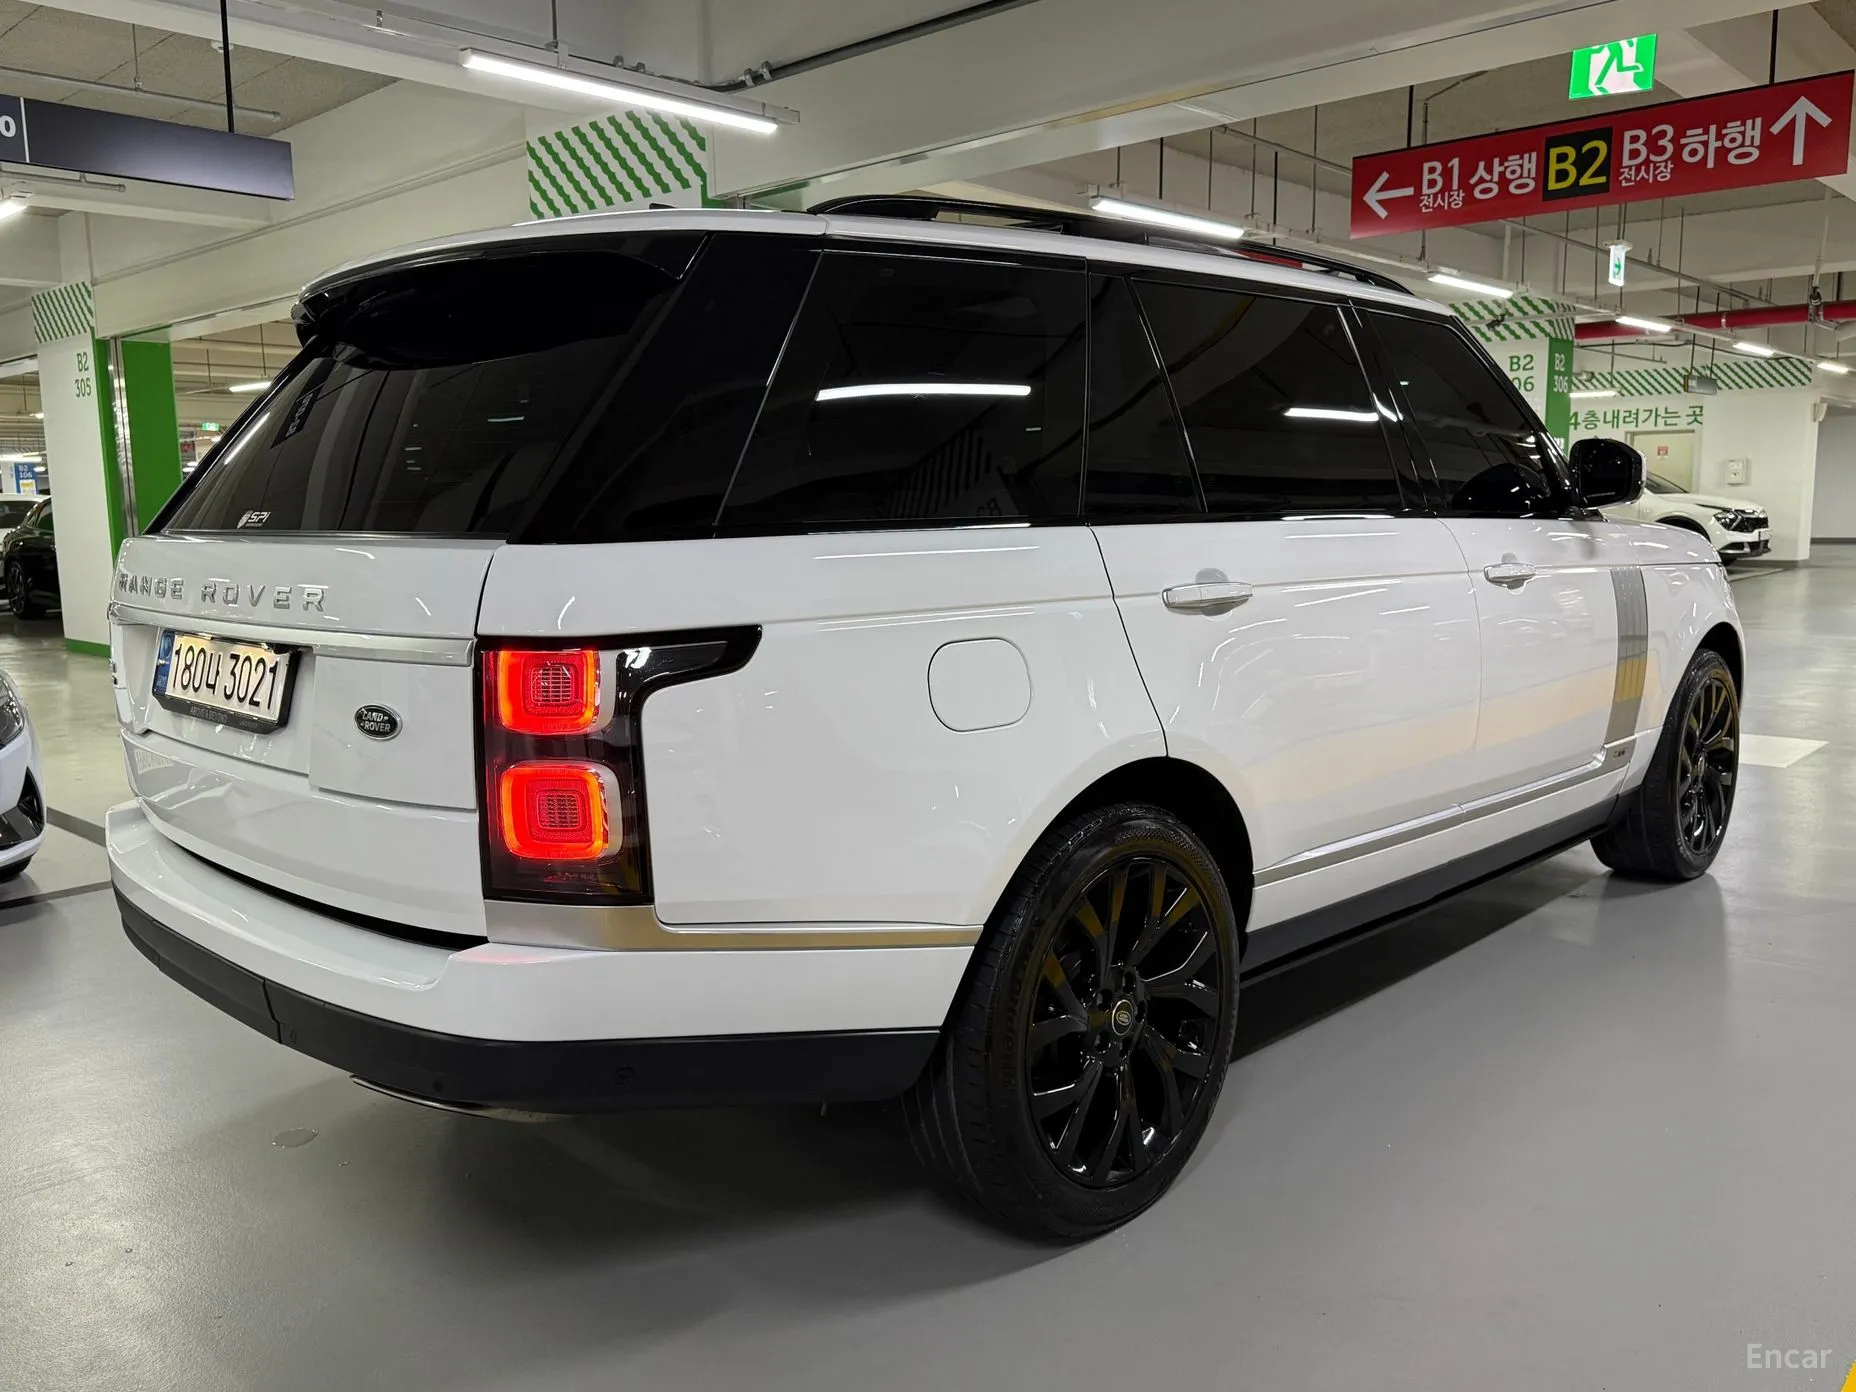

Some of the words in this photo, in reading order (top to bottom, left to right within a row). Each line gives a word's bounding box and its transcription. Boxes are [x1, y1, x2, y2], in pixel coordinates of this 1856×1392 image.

[1622, 124, 1674, 167] B3
[1679, 116, 1763, 169] 하행
[1421, 157, 1460, 195] B1
[1469, 151, 1538, 200] 상행
[1547, 139, 1609, 191] B2
[1618, 160, 1675, 187] 전시장
[1419, 190, 1465, 213] 전시장
[76, 351, 89, 373] B2
[1508, 354, 1535, 372] B2
[1554, 353, 1566, 372] B2
[74, 377, 92, 398] 305
[1511, 375, 1535, 392] 06
[1553, 375, 1569, 393] 306
[1685, 405, 1704, 426] 곳
[118, 573, 185, 600] RANGE
[200, 581, 325, 612] ROVER
[223, 652, 279, 711] 3021
